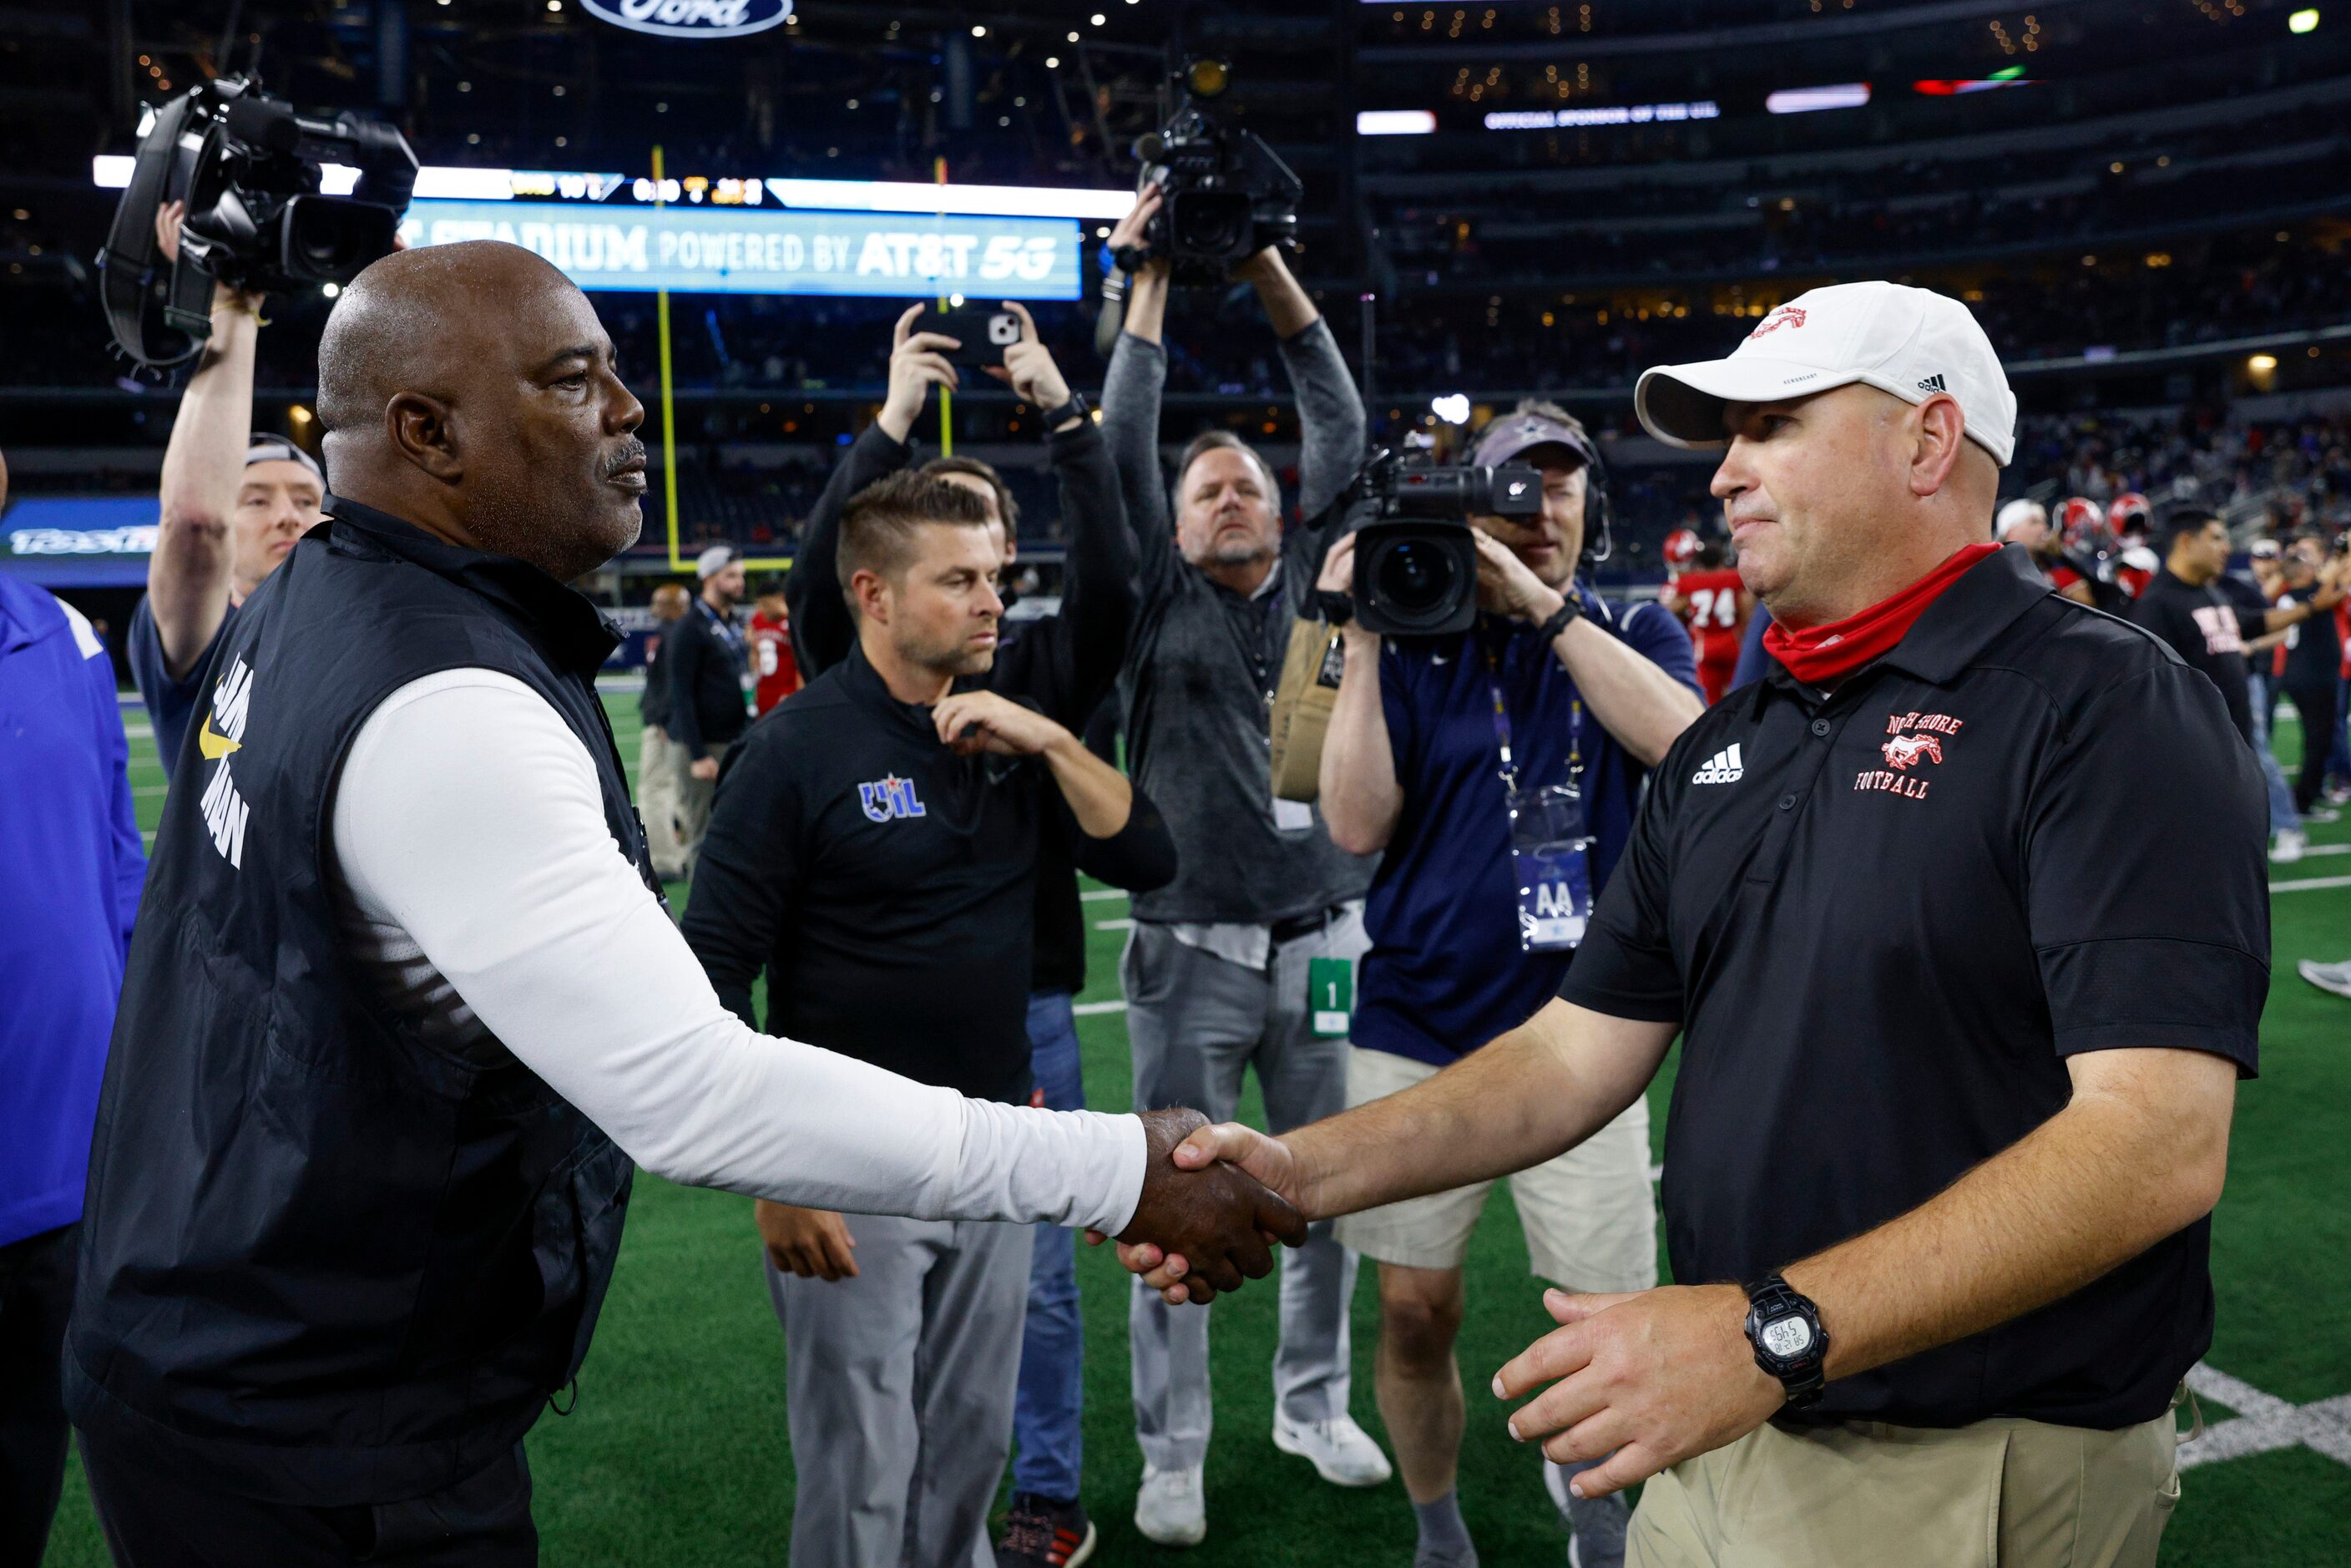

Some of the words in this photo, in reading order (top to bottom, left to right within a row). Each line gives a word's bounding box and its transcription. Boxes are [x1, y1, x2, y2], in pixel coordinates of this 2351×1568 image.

[659, 230, 804, 271] POWERED
[812, 235, 852, 271] BY
[856, 231, 979, 279] AT&T
[978, 235, 1058, 281] 5G
[1918, 382, 1939, 394] adid
[1690, 587, 1736, 628] 74
[1692, 767, 1744, 785] adidas
[1853, 771, 1930, 799] FOOTBALL
[1537, 882, 1575, 917] AA
[1326, 981, 1337, 1009] 1
